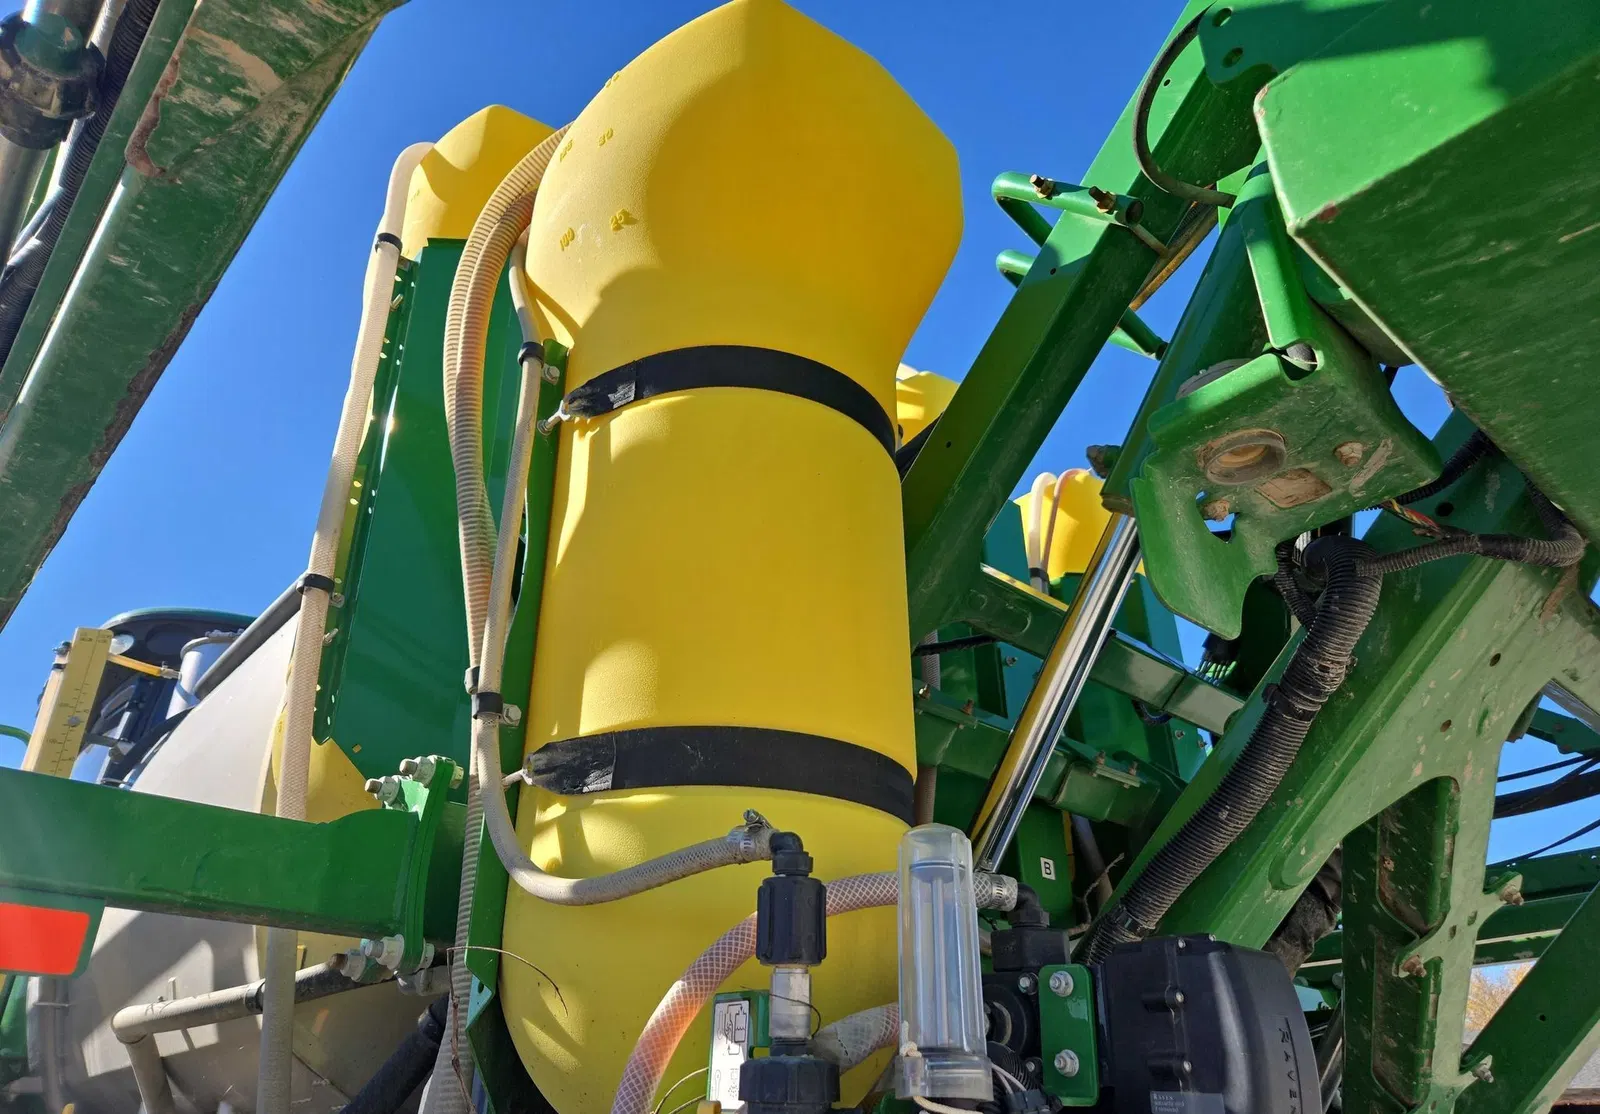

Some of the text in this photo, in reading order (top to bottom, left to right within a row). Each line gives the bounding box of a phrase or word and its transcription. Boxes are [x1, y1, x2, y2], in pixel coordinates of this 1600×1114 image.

[610, 208, 628, 232] 25
[560, 227, 575, 251] 100
[1044, 861, 1052, 875] B
